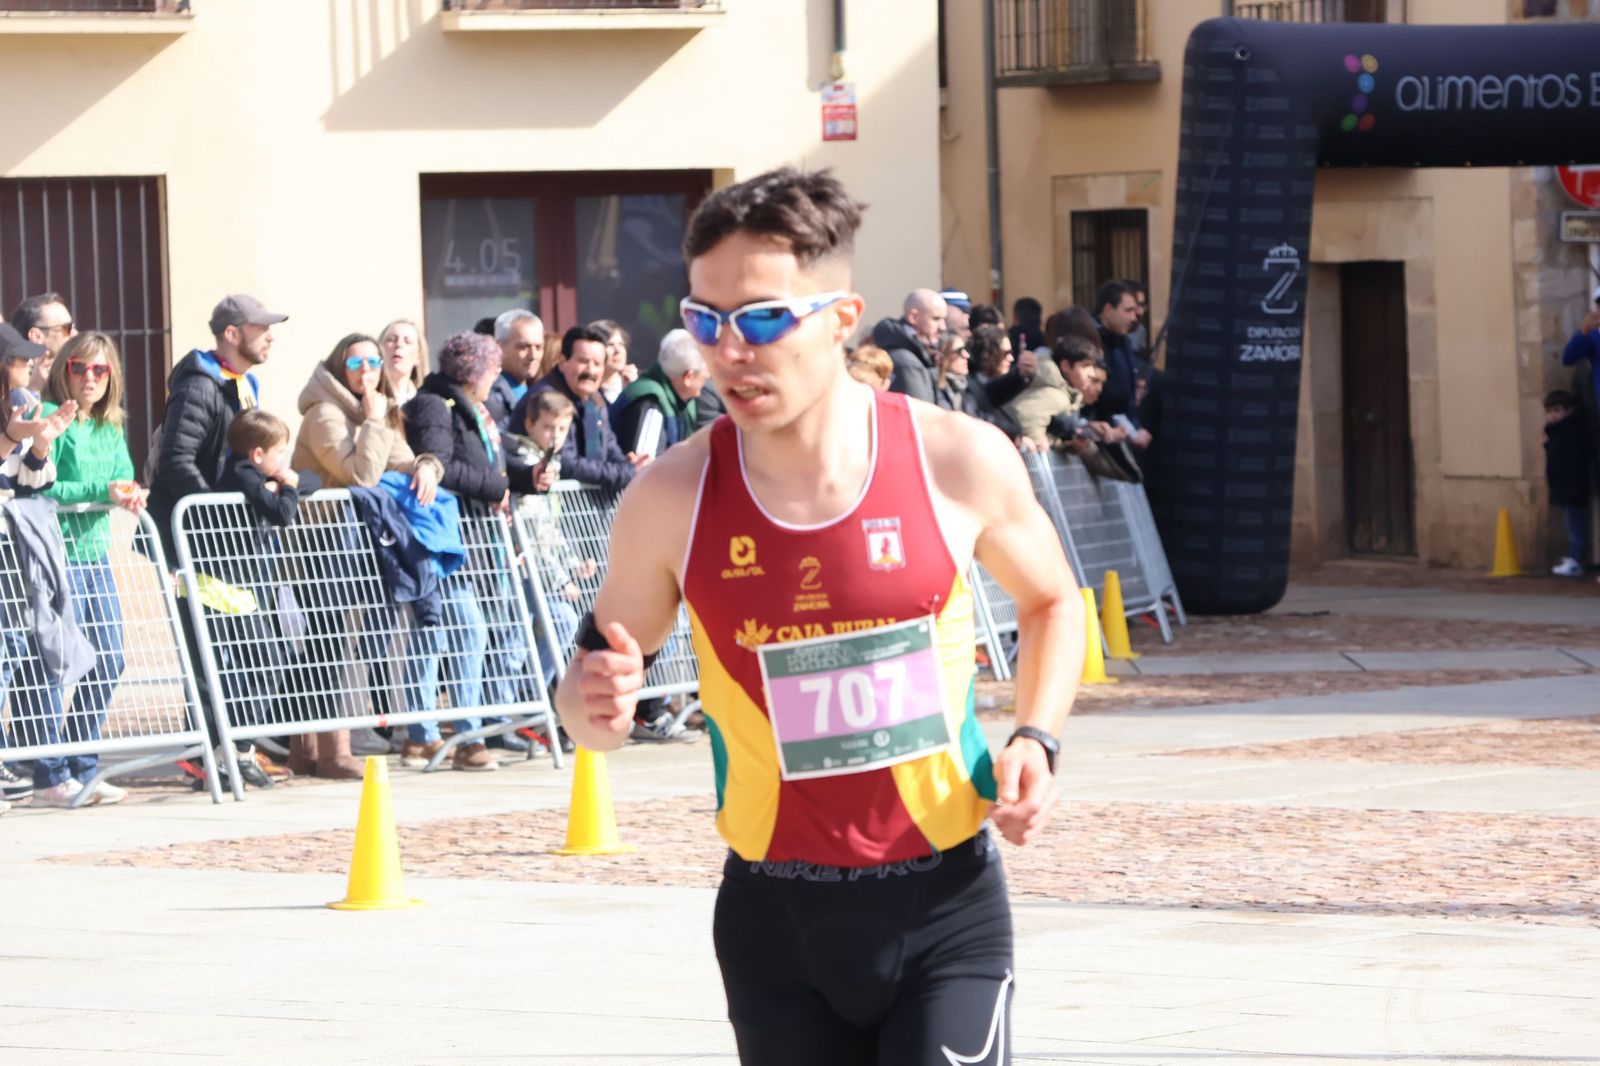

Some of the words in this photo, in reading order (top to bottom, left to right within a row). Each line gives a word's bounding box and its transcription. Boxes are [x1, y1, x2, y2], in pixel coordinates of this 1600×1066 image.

[445, 238, 522, 273] 4.05
[776, 623, 827, 642] CAJA
[799, 660, 907, 734] 707
